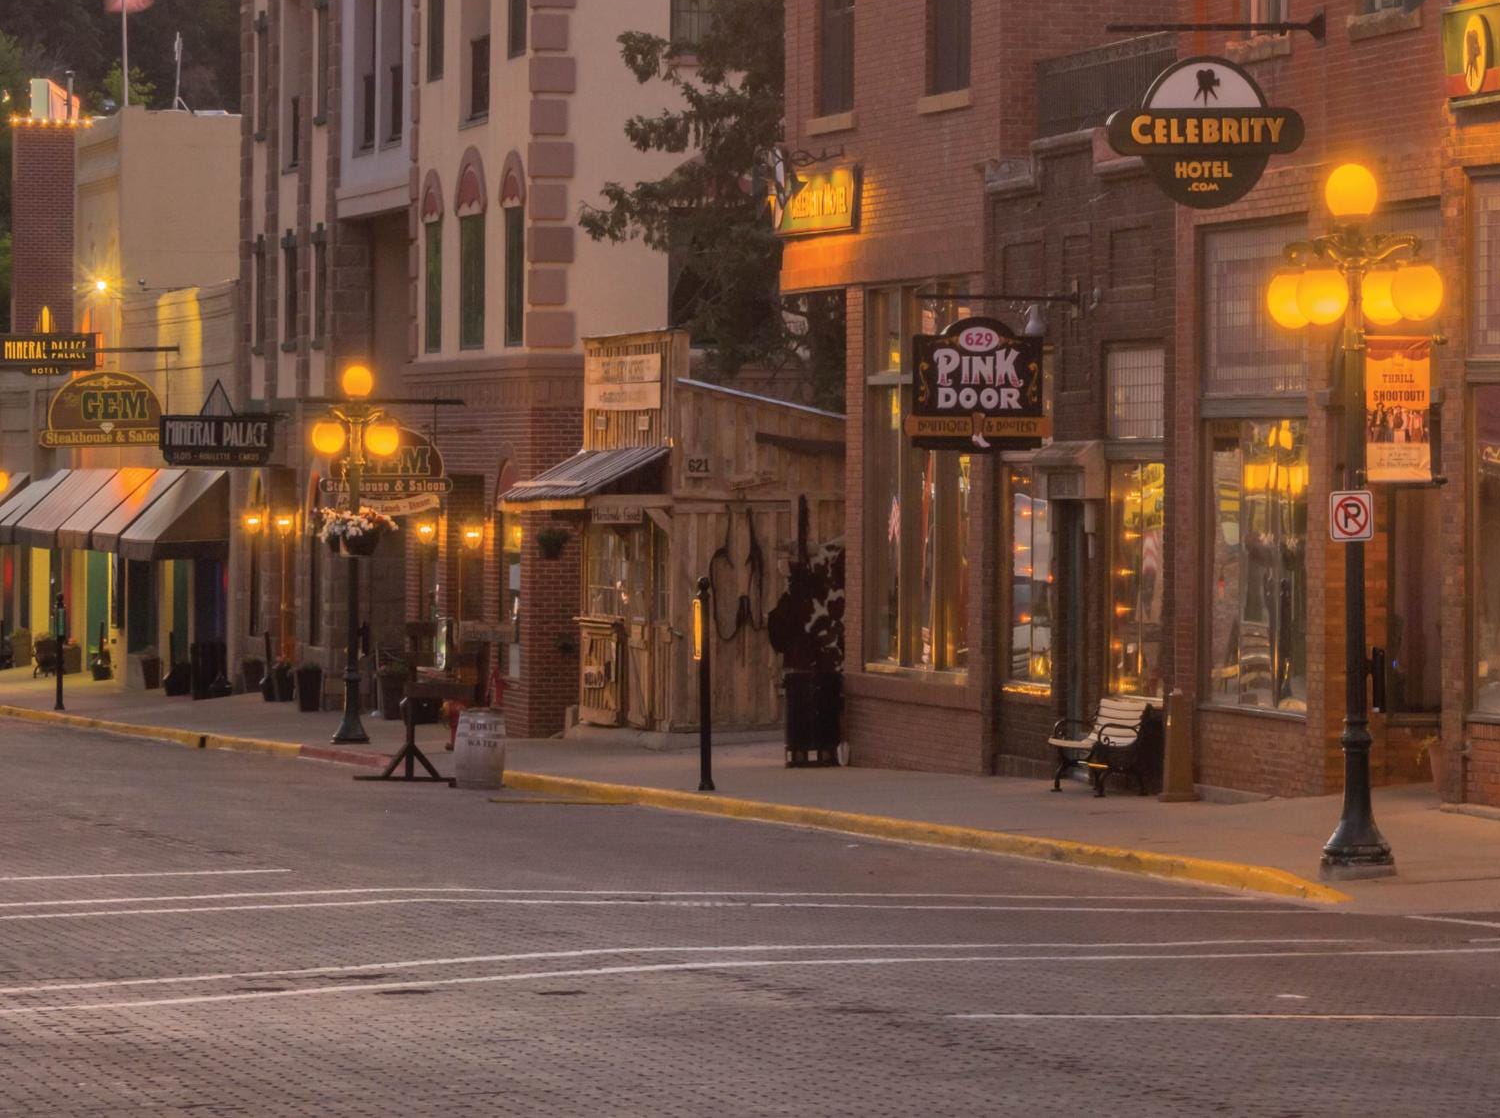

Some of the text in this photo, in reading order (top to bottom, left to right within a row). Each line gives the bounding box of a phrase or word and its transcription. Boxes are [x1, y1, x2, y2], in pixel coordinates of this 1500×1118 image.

[1131, 114, 1286, 145] CELEBRITY
[1174, 161, 1233, 179] HOTEL
[965, 332, 993, 347] 629
[4, 340, 87, 360] MINERAL PALACE
[933, 348, 1024, 388] PINK
[1382, 374, 1415, 383] THRILL
[81, 389, 149, 421] GEM
[937, 387, 1022, 409] DOOR
[1373, 390, 1424, 402] SHOOTOUT!
[46, 431, 160, 445] Steakhouse & Saloo
[165, 421, 268, 447] MINERAL PALACE
[688, 458, 710, 473] 621
[409, 481, 446, 492] Saloon
